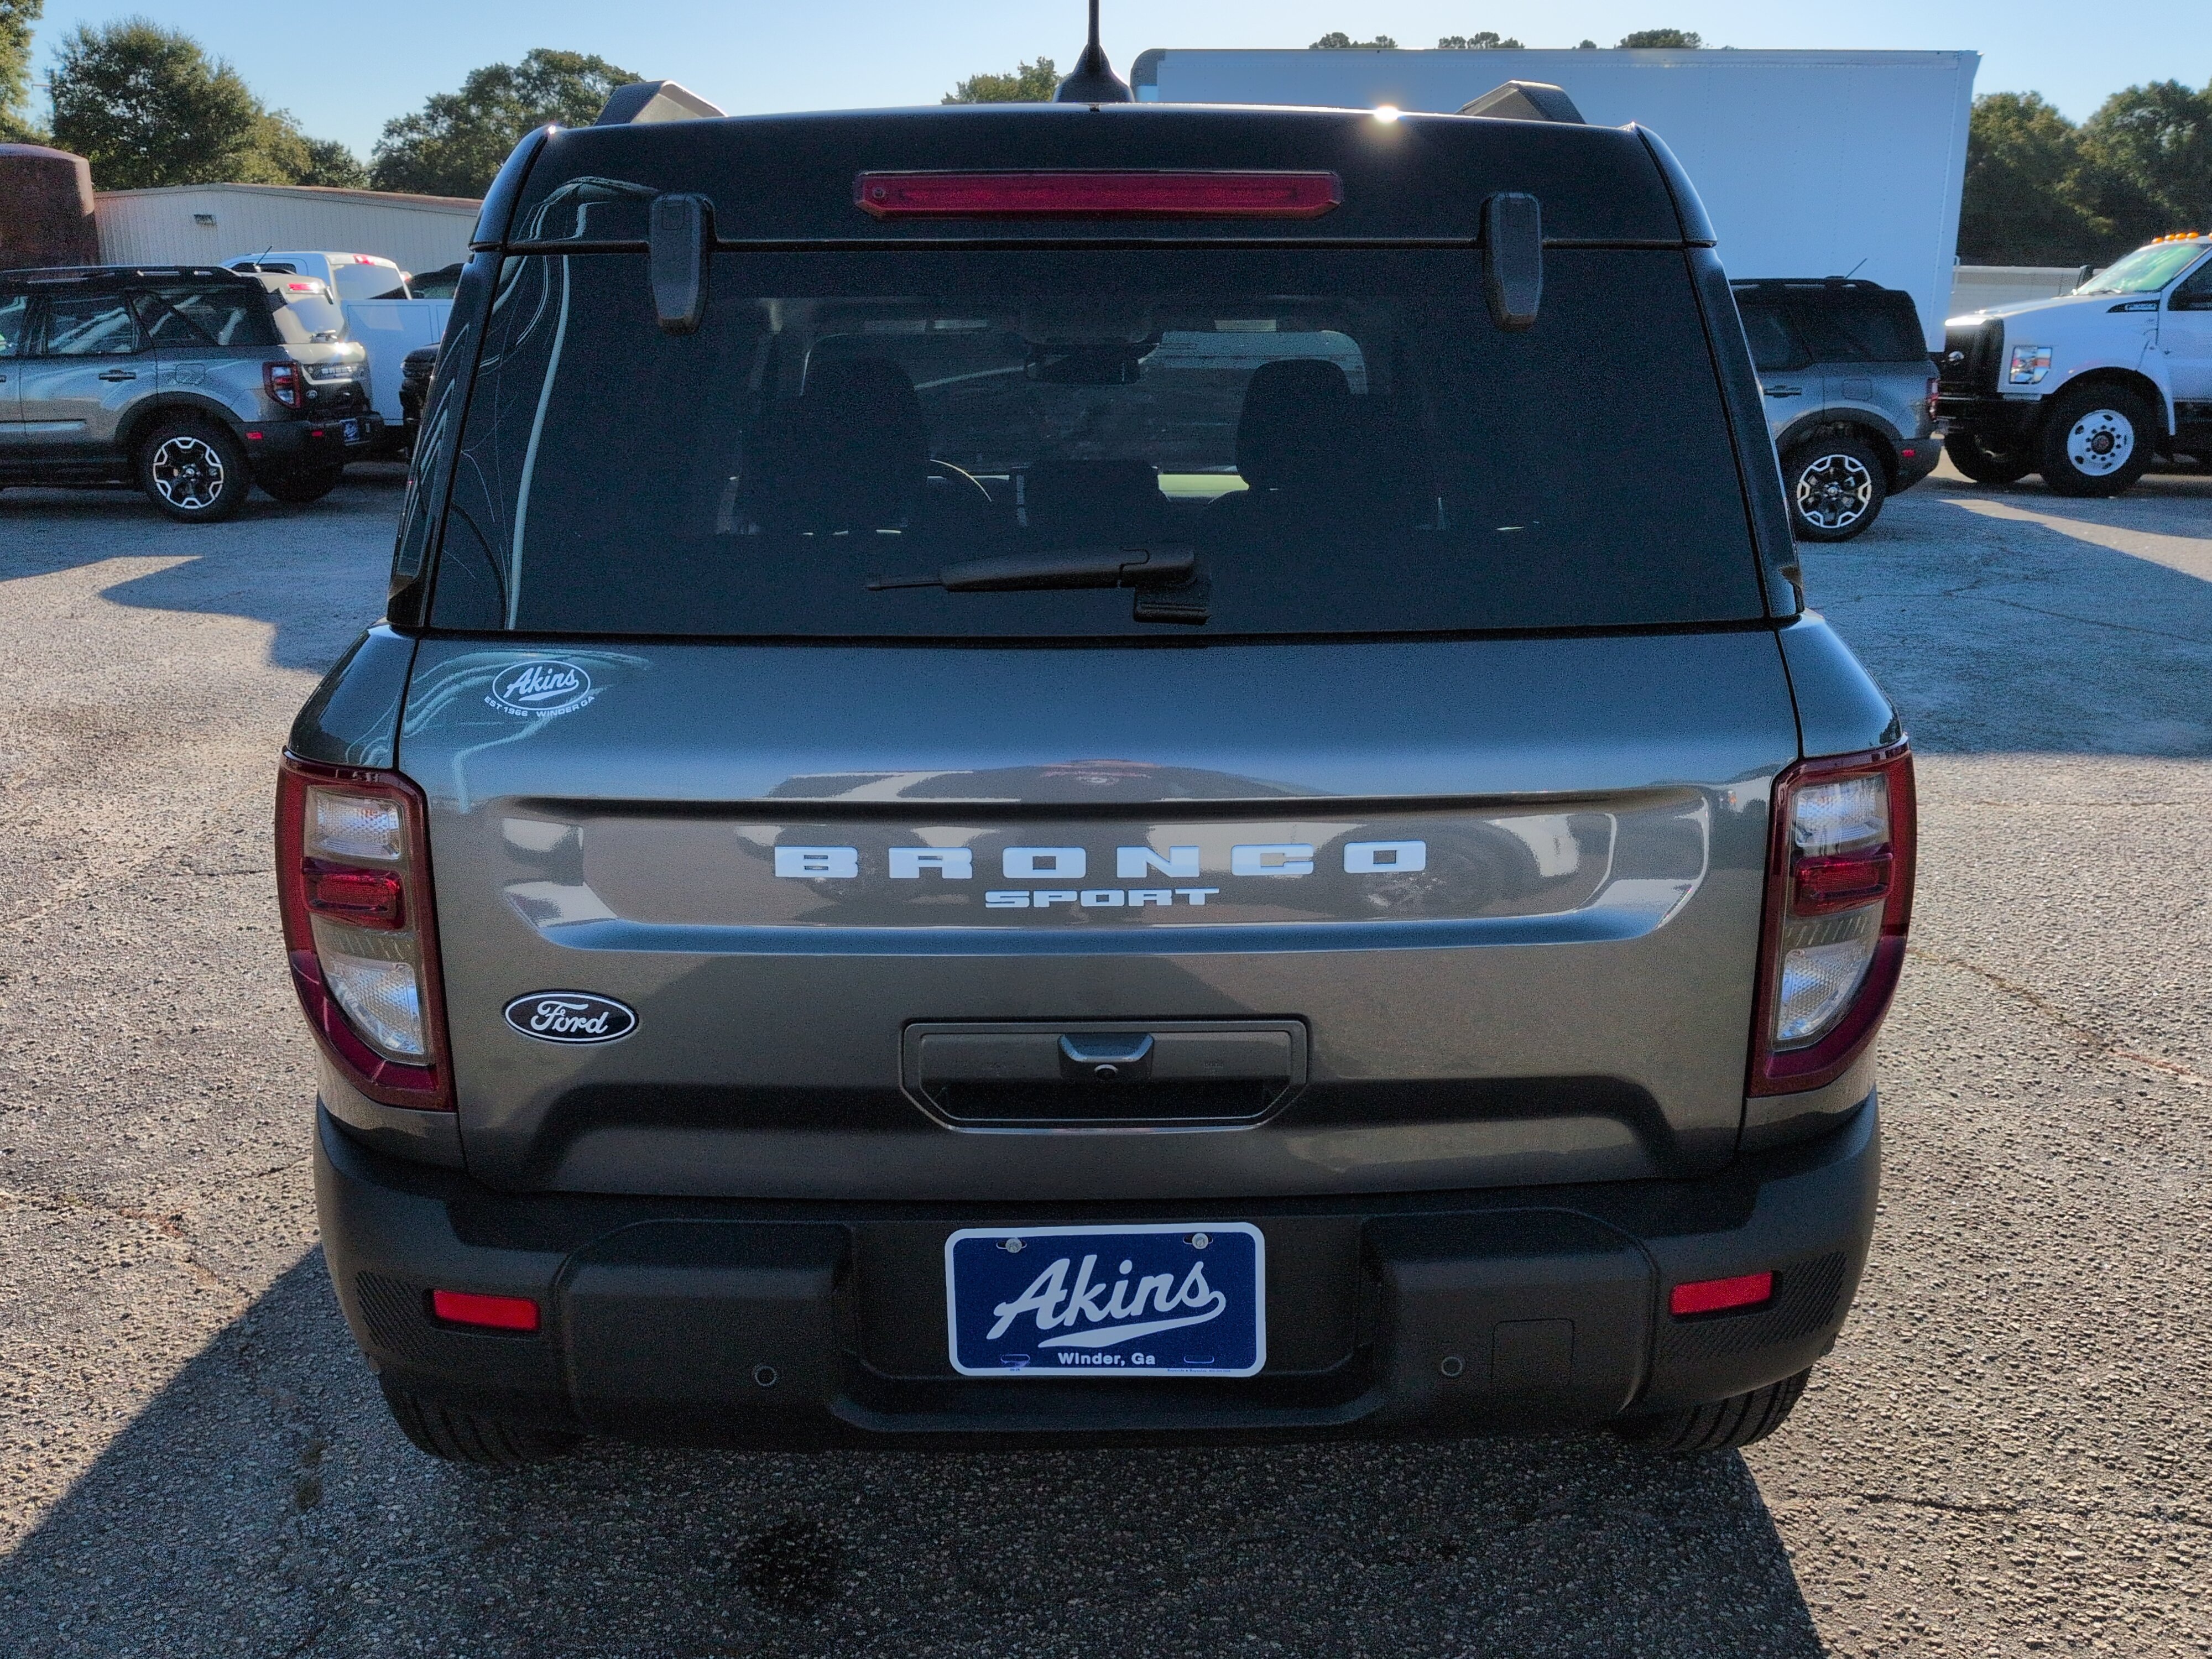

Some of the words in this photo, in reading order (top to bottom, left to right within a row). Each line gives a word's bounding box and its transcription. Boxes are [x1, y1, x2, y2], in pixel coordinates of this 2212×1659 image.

[503, 666, 580, 701] Akins
[484, 696, 503, 709] EST
[503, 706, 528, 717] 1966
[536, 705, 580, 717] WINDER
[581, 696, 595, 707] GA
[774, 840, 1426, 879] BRONCO
[985, 888, 1219, 908] SPORT
[530, 1000, 609, 1034] Ford
[986, 1254, 1227, 1348] Akins
[1057, 1352, 1126, 1366] Winder,
[1131, 1352, 1156, 1365] Ga
